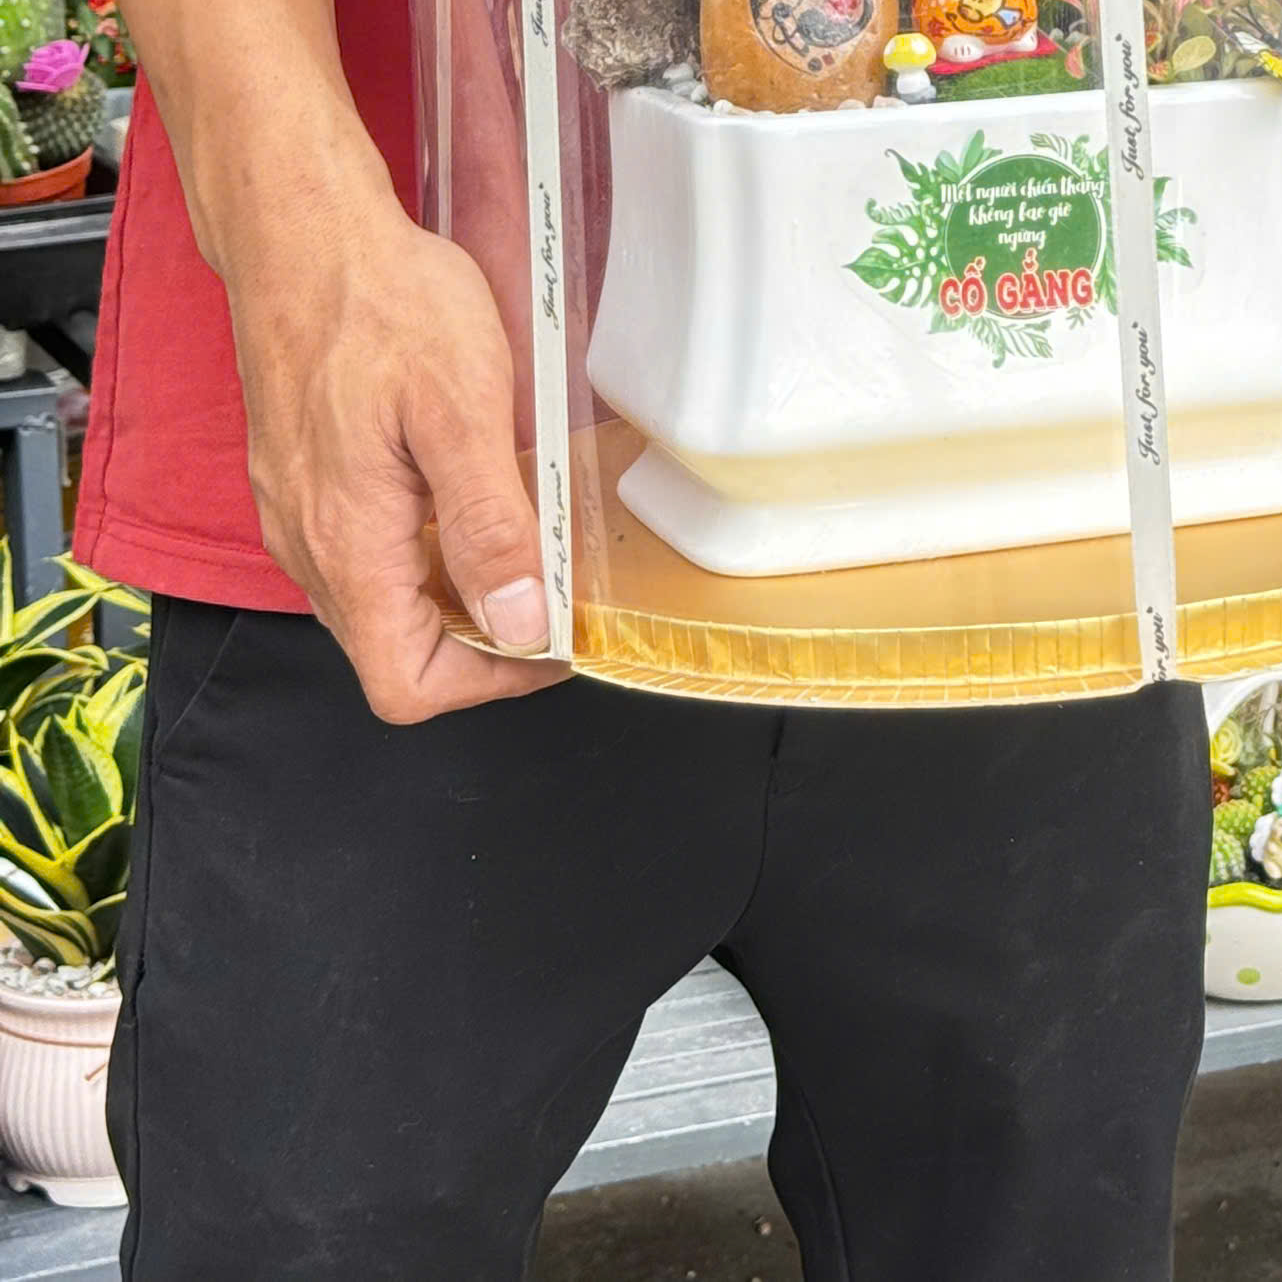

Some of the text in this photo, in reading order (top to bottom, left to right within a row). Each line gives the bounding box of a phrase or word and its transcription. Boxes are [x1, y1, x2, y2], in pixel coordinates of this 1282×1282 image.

[1118, 40, 1144, 181] Just for you
[939, 255, 988, 318] CỐ
[1135, 327, 1160, 465] Just for you
[1153, 612, 1169, 660] you
